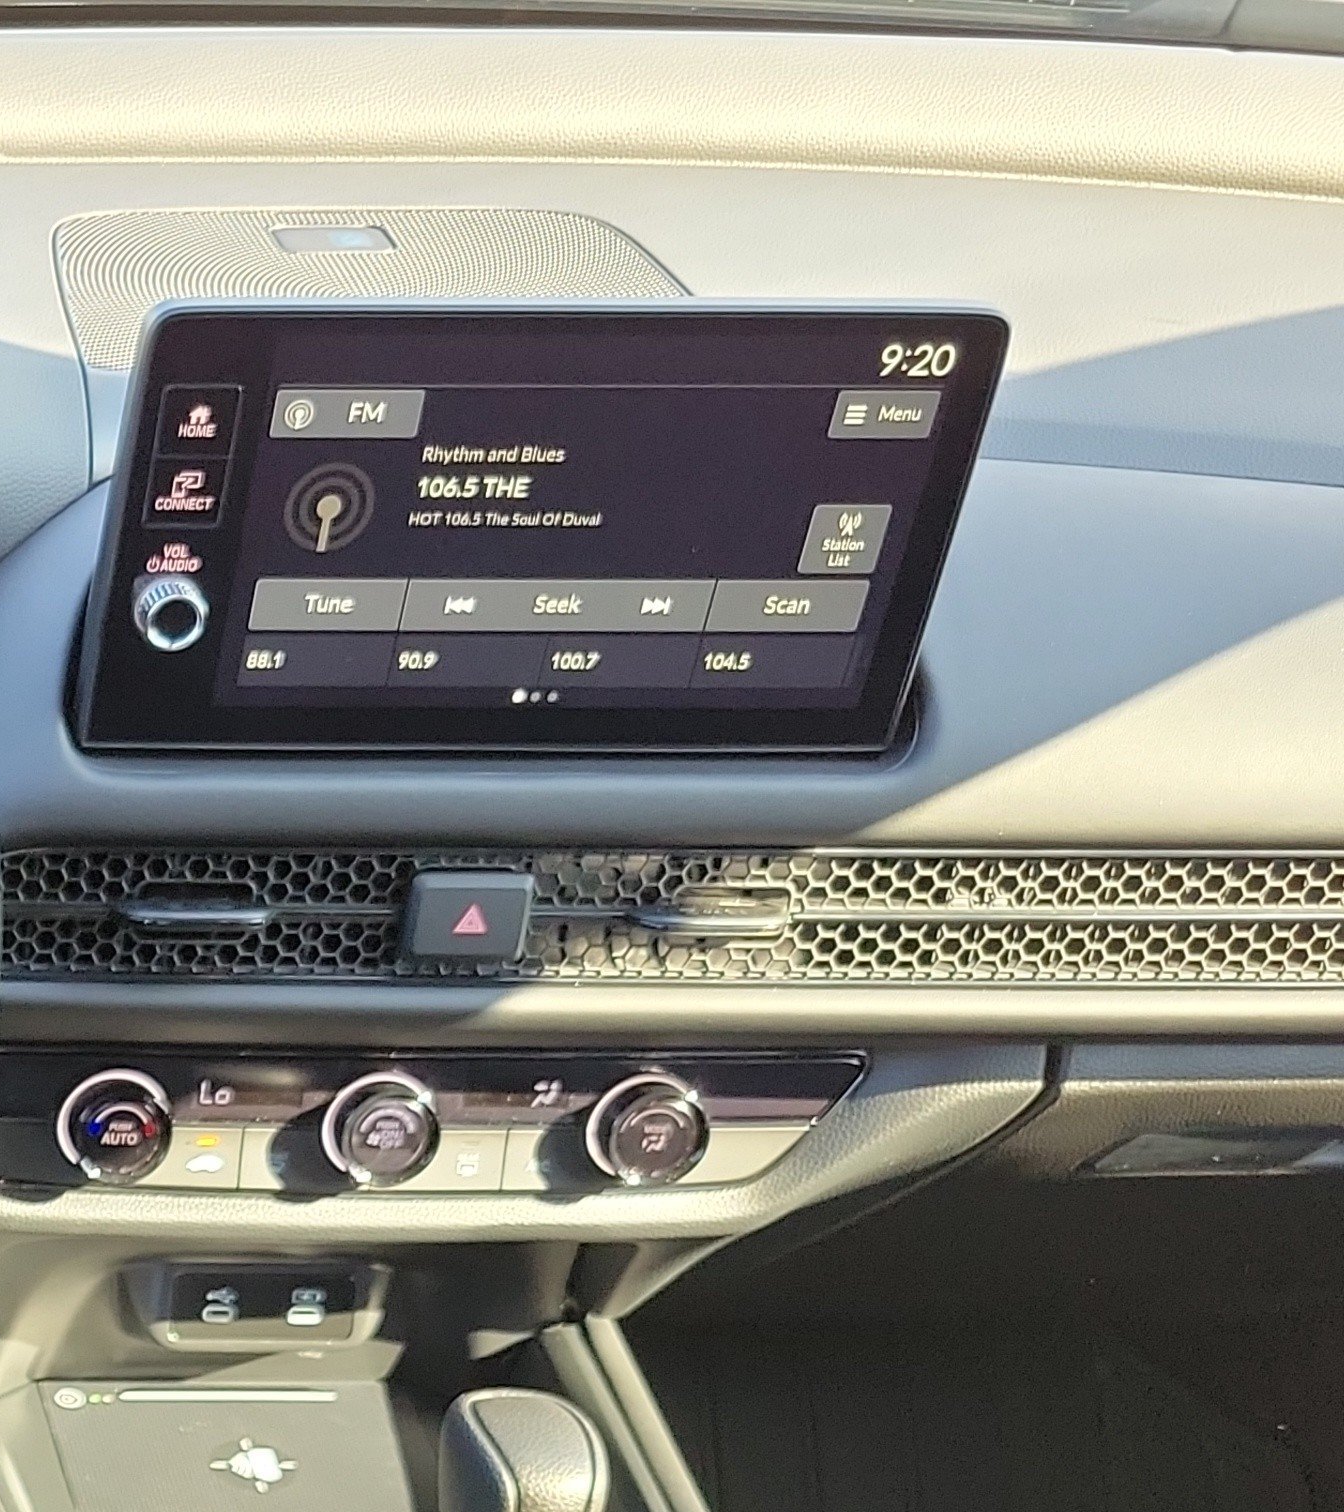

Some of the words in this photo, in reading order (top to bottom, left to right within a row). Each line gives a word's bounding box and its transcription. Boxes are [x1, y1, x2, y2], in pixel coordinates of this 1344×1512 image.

[879, 343, 957, 378] 9:20
[347, 402, 387, 423] FM
[878, 406, 922, 423] Menu
[178, 423, 217, 438] HOME
[422, 445, 484, 465] Rhythm
[487, 446, 518, 462] and
[520, 445, 566, 463] Blues
[417, 476, 480, 498] 106.5
[482, 476, 533, 498] THE
[154, 497, 216, 511] CONNECT
[408, 512, 442, 526] HOT
[445, 513, 481, 526] 106.5
[484, 512, 508, 526] The
[511, 512, 540, 526] Soul
[542, 512, 561, 526] Of
[563, 512, 603, 527] Duval
[163, 543, 190, 558] VOL
[821, 537, 865, 552] Station
[160, 557, 203, 573] AUDIO
[827, 553, 852, 567] List
[305, 594, 355, 614] Tune
[533, 594, 583, 614] Seek
[763, 595, 811, 615] Scan
[246, 650, 287, 670] 88.1
[398, 650, 440, 670] 90.9
[551, 651, 602, 671] 100.7
[703, 651, 753, 671] 104.5
[100, 1132, 139, 1146] AUTO
